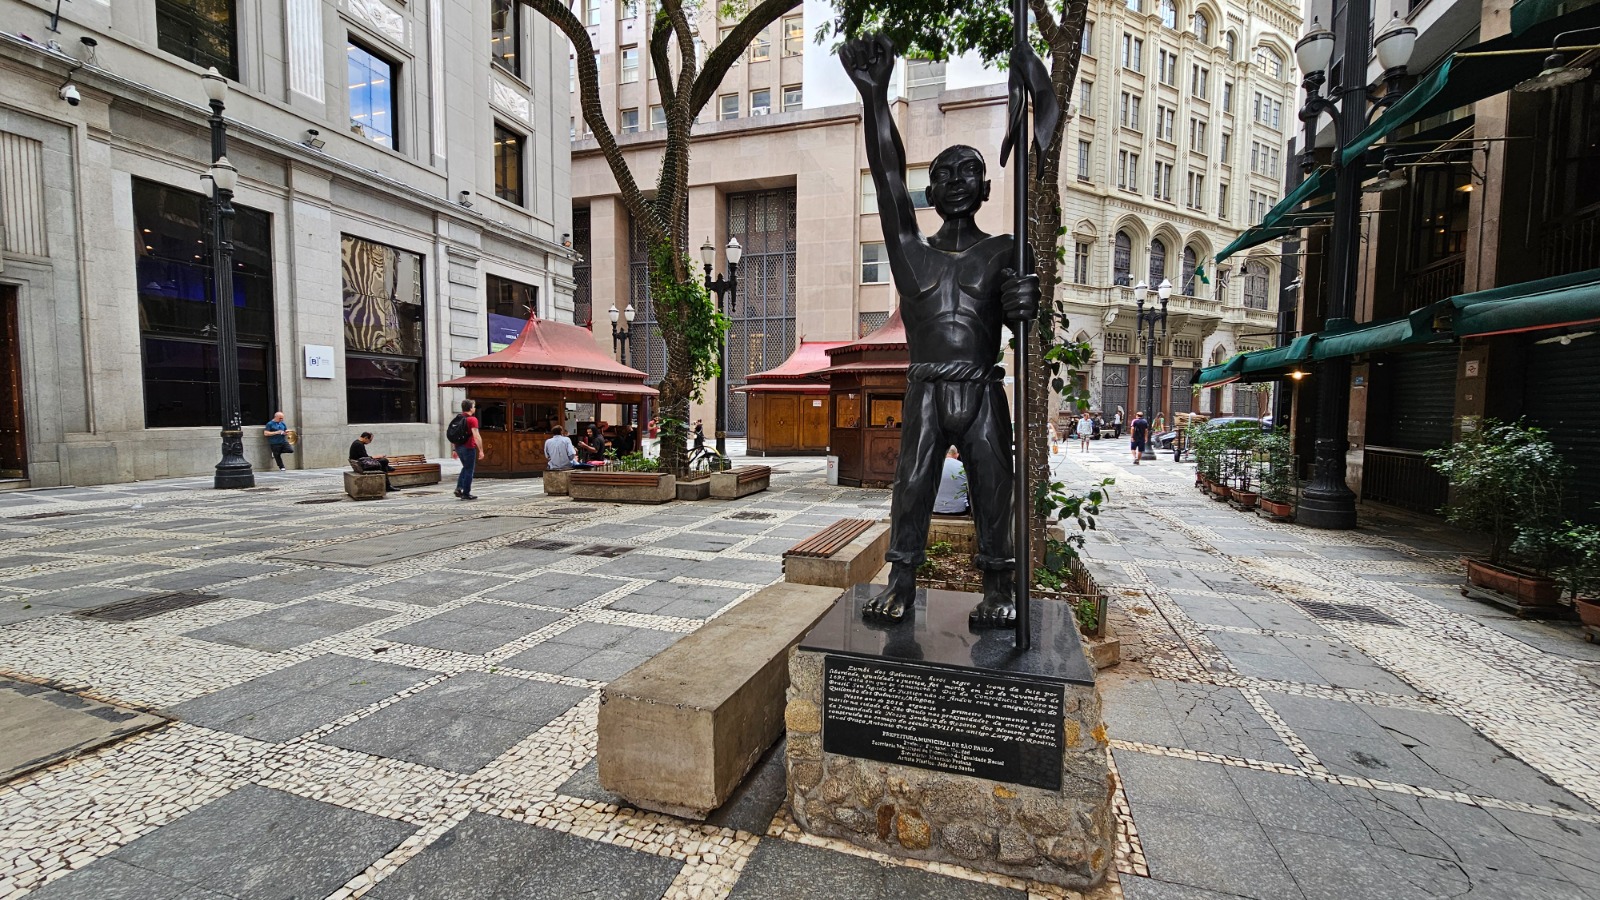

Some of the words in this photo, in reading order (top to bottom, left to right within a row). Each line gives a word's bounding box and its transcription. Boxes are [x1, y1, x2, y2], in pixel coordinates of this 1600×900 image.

[829, 686, 860, 694] Quilombo
[1010, 694, 1046, 702] novembro
[838, 704, 873, 714] Irmandade
[909, 715, 938, 723] Senhora
[985, 714, 1028, 724] monumento
[882, 731, 918, 742] PREFEITURA
[918, 737, 951, 747] MUNICIPAL
[931, 723, 954, 732] XVIII
[990, 733, 1014, 742] Largo
